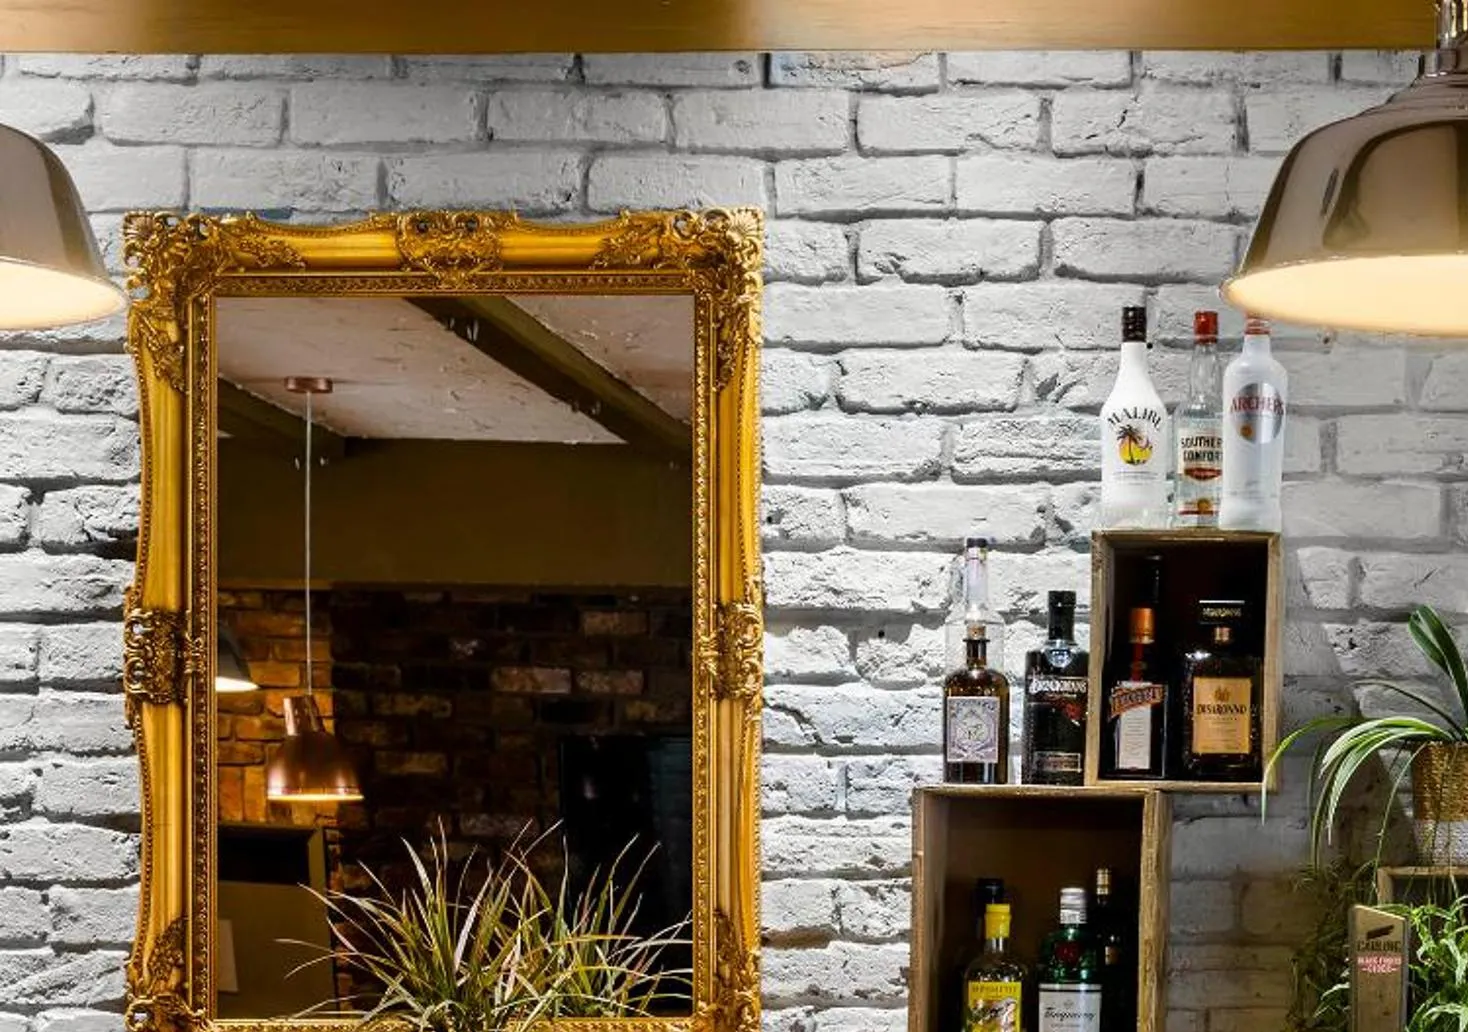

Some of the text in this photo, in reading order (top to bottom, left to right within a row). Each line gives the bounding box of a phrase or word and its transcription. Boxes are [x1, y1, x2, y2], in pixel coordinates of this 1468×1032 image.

[1231, 396, 1284, 415] ARCHERS
[1181, 436, 1222, 449] SOUTHER
[1183, 451, 1222, 462] COMFOR
[1196, 704, 1247, 715] DISARONNO
